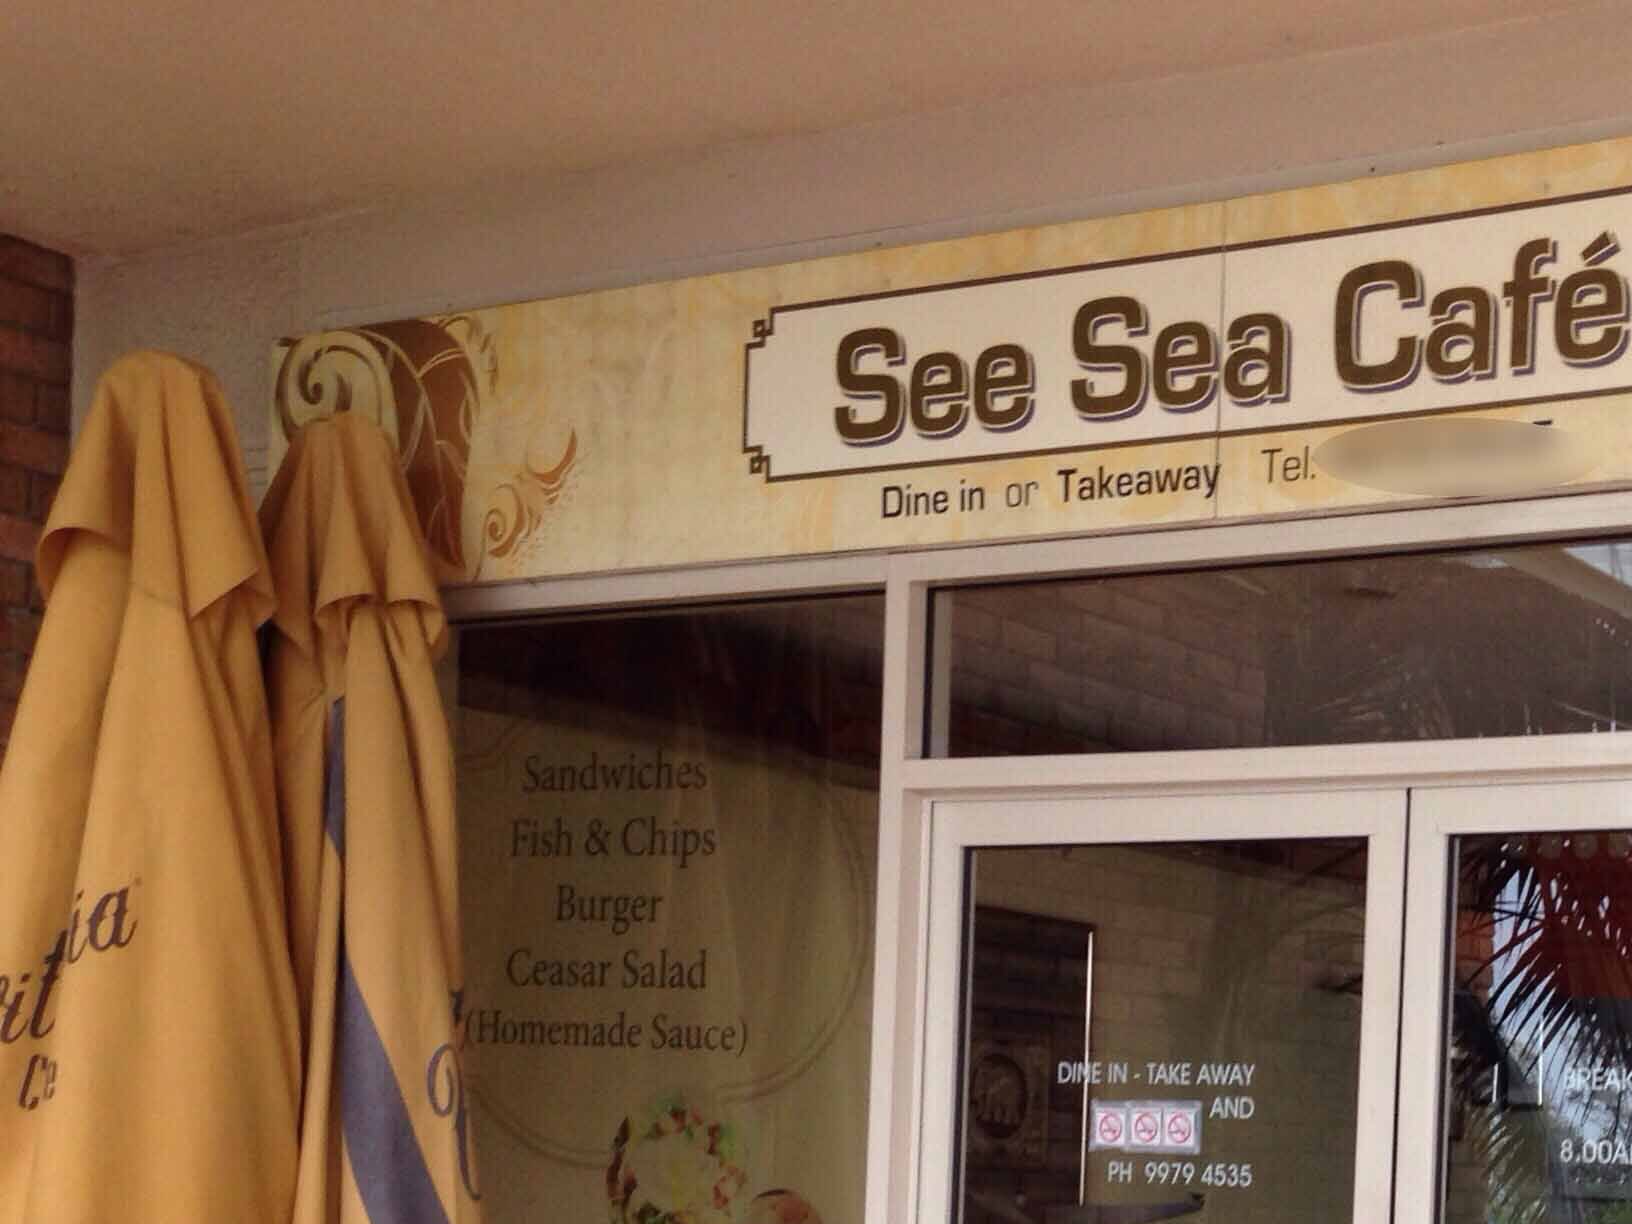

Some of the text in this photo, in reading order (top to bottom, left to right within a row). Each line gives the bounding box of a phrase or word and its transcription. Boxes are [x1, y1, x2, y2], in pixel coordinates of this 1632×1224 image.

[833, 232, 1631, 448] See Sea Café
[881, 482, 949, 520] Dine
[959, 478, 985, 513] in
[1005, 481, 1039, 509] or
[1056, 462, 1222, 505] Takeaway
[1260, 446, 1318, 486] Tel.
[522, 750, 708, 793] Sandwiches
[510, 815, 716, 868] Fish & Chips
[555, 885, 663, 936] Burger
[506, 948, 707, 990] Ceasar Salad
[464, 1010, 747, 1057] (Homemade Sauce)
[1057, 1061, 1101, 1084] DINE
[1107, 1062, 1128, 1084] IN
[1147, 1063, 1191, 1085] TAKE
[1196, 1063, 1256, 1087] AWAY
[1209, 1096, 1255, 1120] AND
[1107, 1162, 1252, 1187] PH 9979 4535
